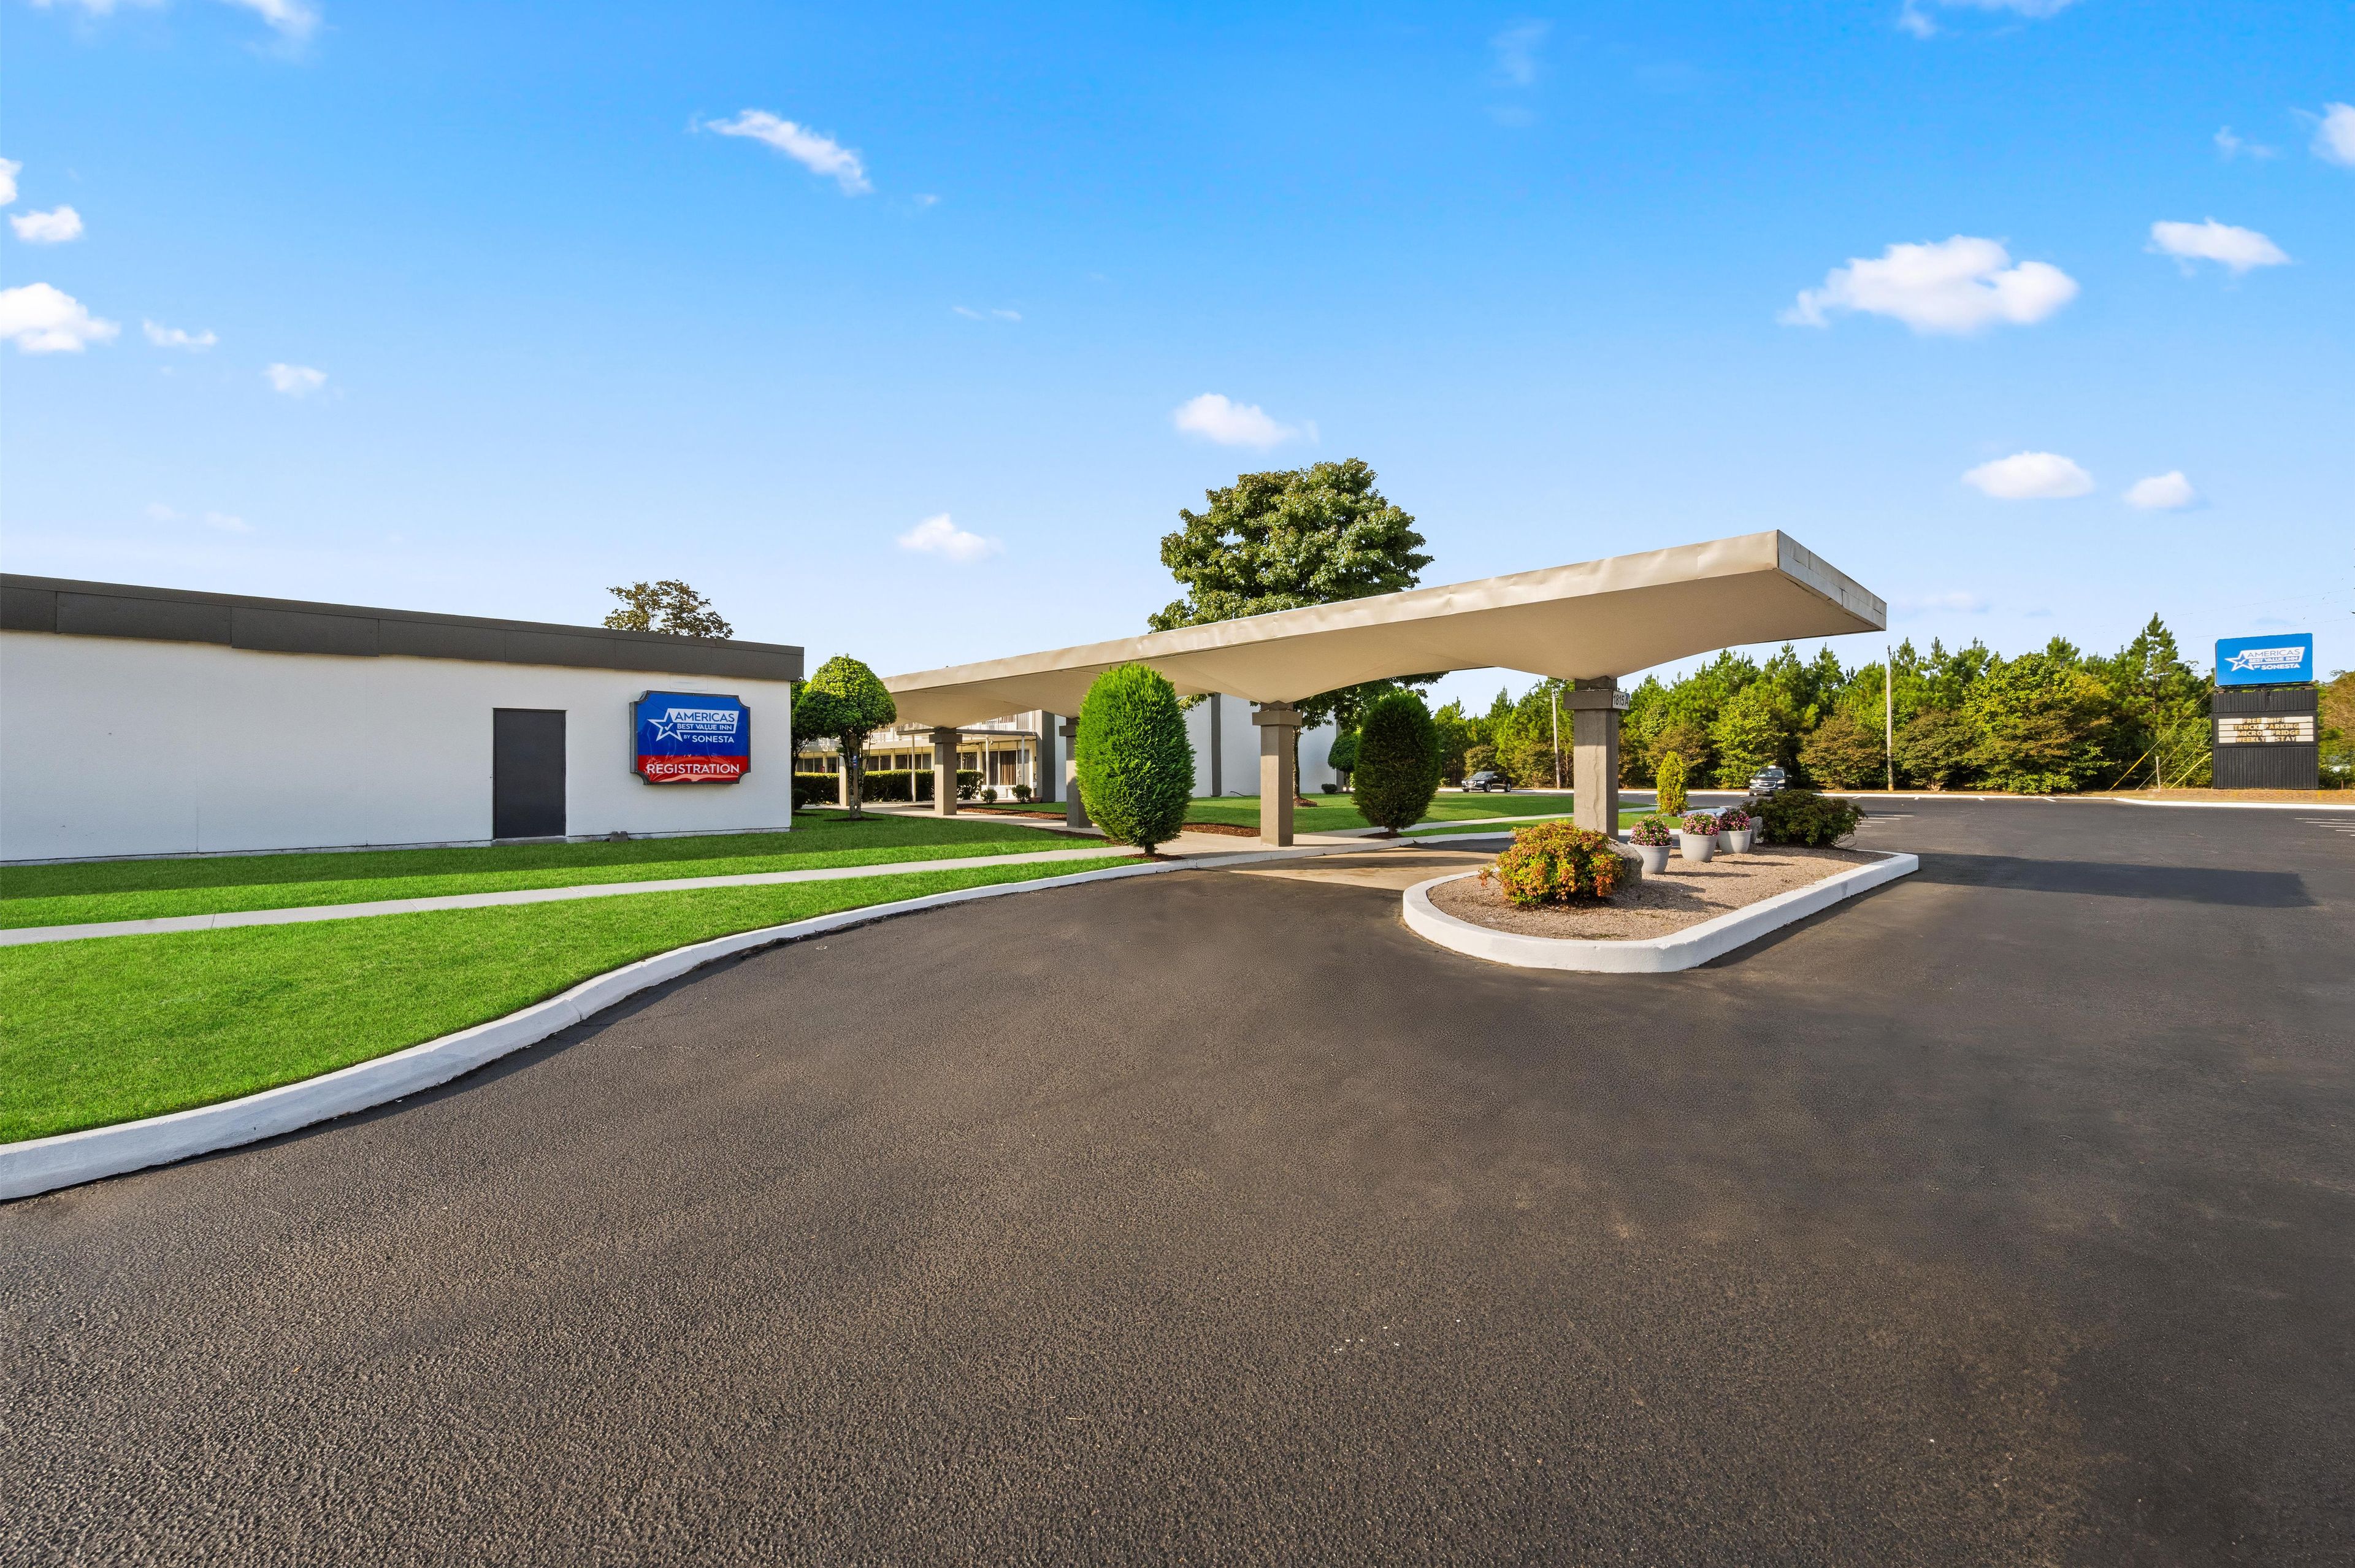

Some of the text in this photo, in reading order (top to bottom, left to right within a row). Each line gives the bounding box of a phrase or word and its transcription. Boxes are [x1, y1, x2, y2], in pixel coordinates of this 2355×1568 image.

[2247, 649, 2300, 657] AMERICAS
[675, 711, 735, 722] AMERICAS
[692, 735, 735, 743] SONESTA
[646, 763, 740, 774] REGISTRATION
